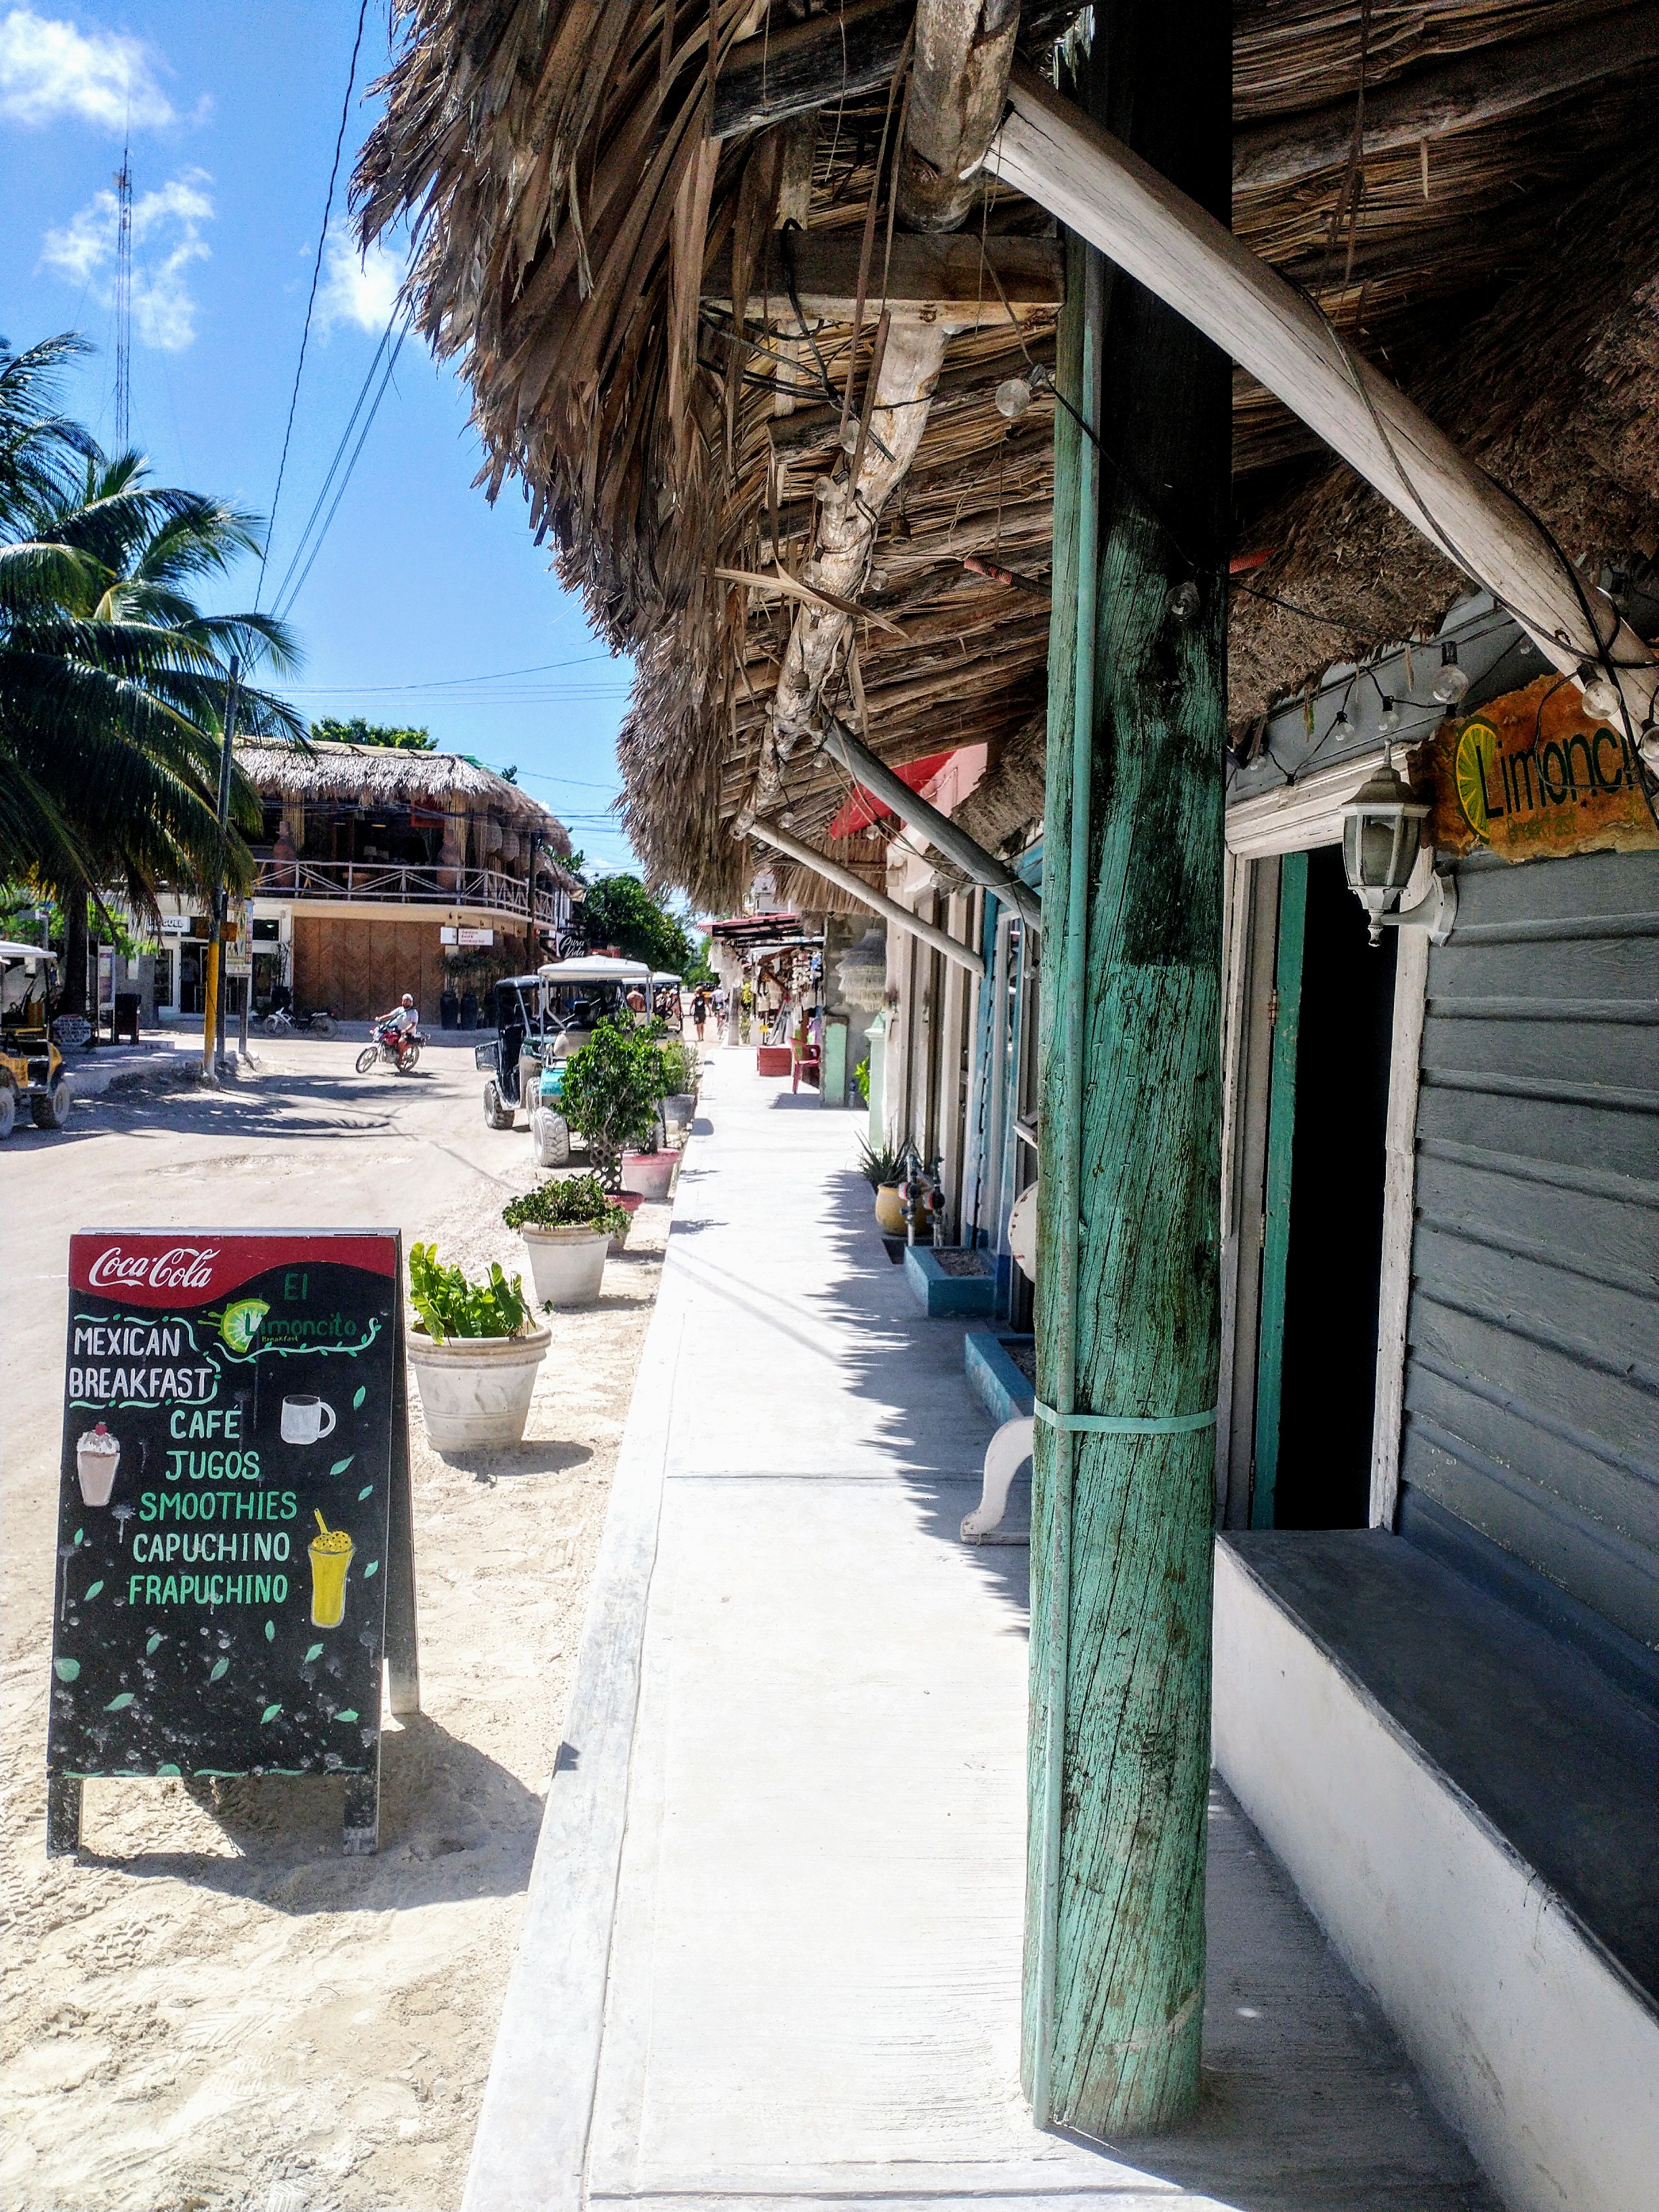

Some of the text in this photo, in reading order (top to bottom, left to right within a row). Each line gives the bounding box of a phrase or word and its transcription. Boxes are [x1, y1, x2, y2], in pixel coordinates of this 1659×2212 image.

[560, 936, 585, 951] Pura
[564, 946, 585, 959] Vida
[89, 1247, 220, 1287] Coca-Cola
[285, 1273, 308, 1300] El
[245, 1312, 357, 1337] Limoncito
[262, 1334, 298, 1343] Breakfast
[74, 1328, 180, 1356] MEXICAN
[70, 1368, 212, 1398] BREAKFAST
[170, 1404, 241, 1439] CAFÉ
[165, 1451, 259, 1480] JUGOS
[139, 1491, 297, 1521] SMOOTHIES
[133, 1532, 289, 1563] CAPUCHINO
[129, 1574, 287, 1604] FRAPUCHINO
